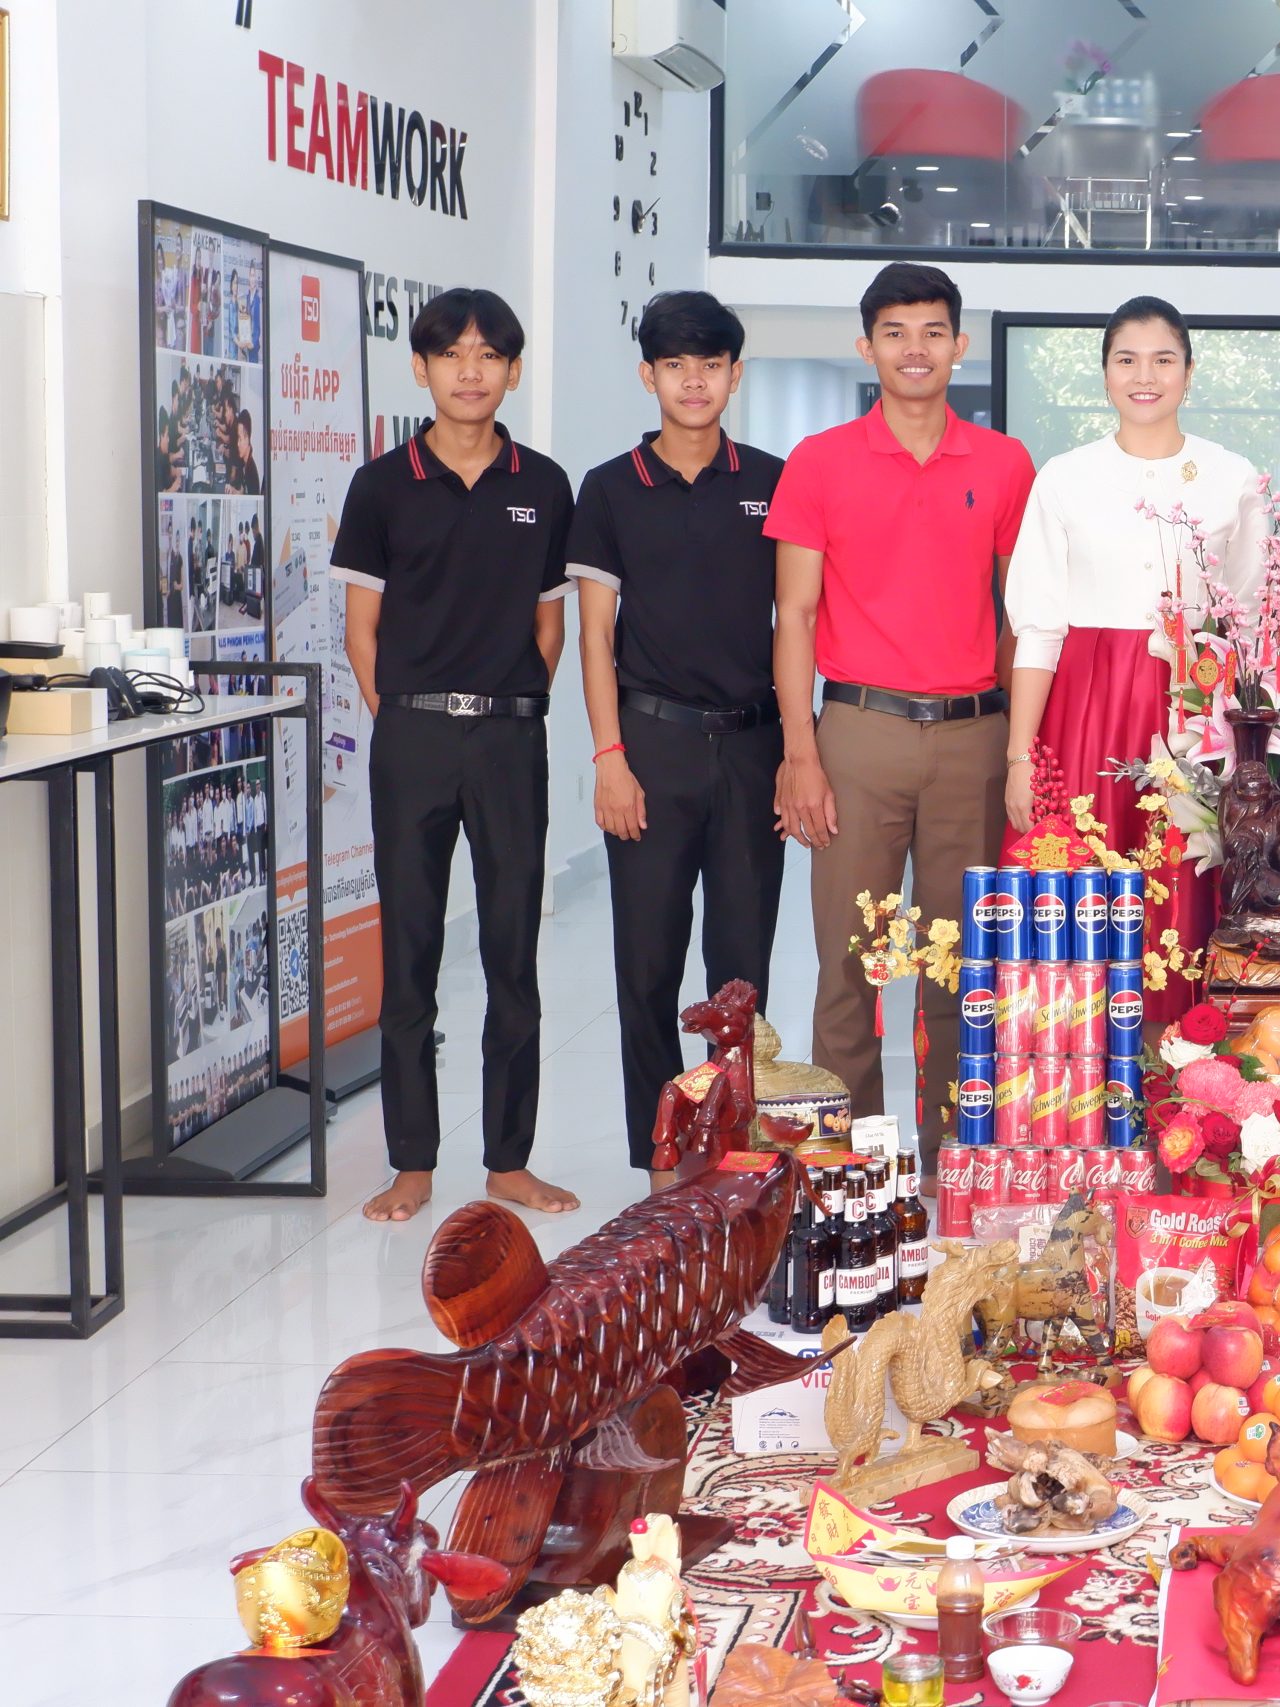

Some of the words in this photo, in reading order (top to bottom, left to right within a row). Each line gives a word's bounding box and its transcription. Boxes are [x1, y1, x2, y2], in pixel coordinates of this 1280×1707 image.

[258, 50, 468, 220] TEAMWORK
[364, 270, 399, 342] KES
[313, 368, 340, 402] APP
[975, 908, 998, 917] PEP
[1033, 908, 1065, 918] PEPSI
[1077, 909, 1107, 918] PEPS
[1111, 908, 1144, 918] PEPSI
[963, 1003, 995, 1013] PEPSI
[1110, 1005, 1142, 1014] PEPSI
[960, 1094, 992, 1103] PEPSI
[1150, 1209, 1186, 1231] Gold
[1187, 1213, 1227, 1233] Roas
[1179, 1236, 1209, 1249] Coffee
[1210, 1236, 1229, 1247] Mix
[839, 1273, 877, 1289] CAMBOD
[800, 1372, 832, 1389] VID
